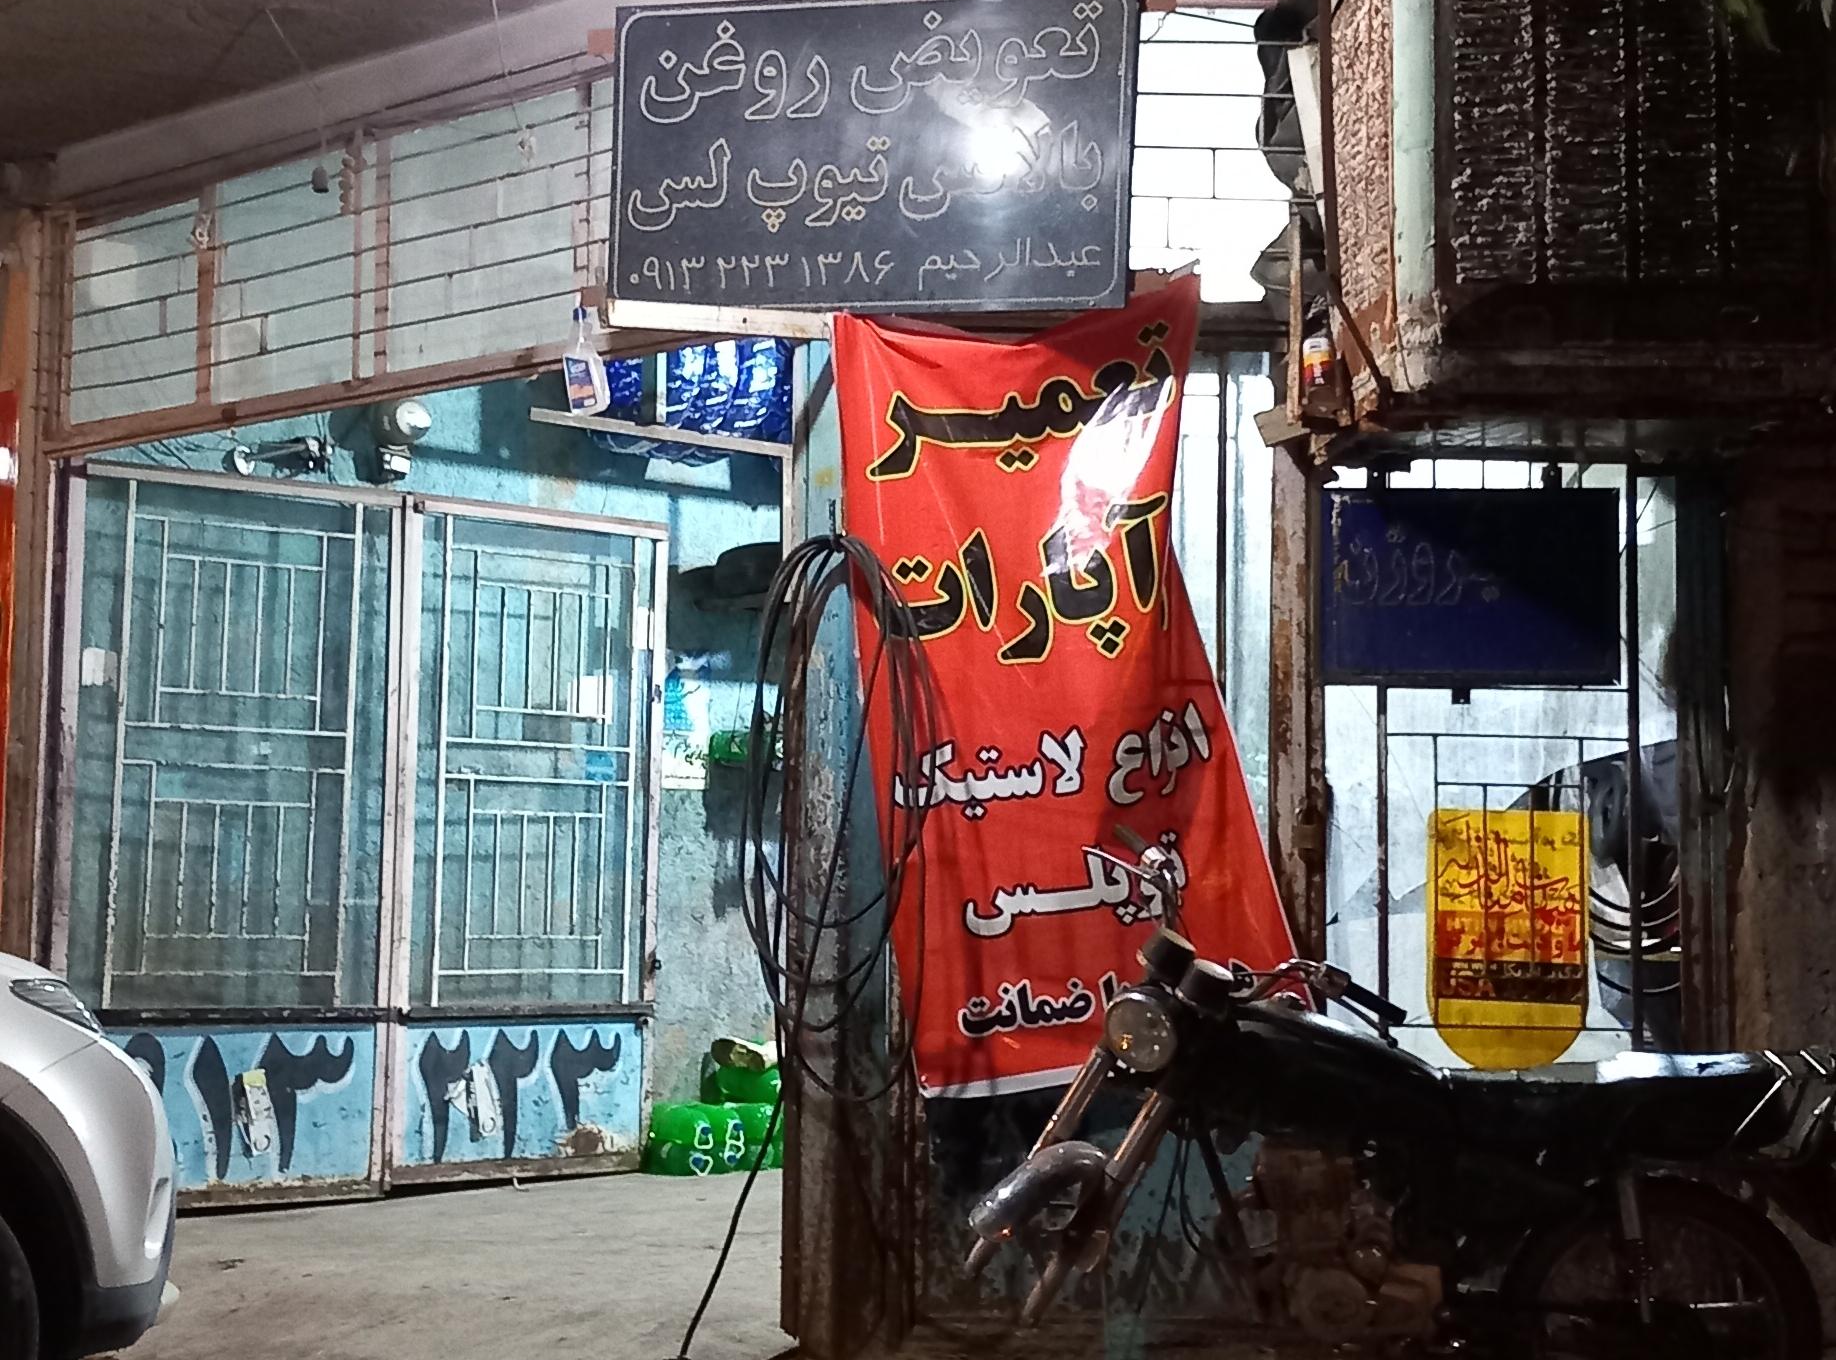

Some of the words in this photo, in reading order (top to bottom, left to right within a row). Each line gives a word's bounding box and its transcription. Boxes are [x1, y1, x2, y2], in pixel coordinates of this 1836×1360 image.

[639, 20, 831, 124] روغن
[850, 0, 1104, 114] تعویض
[627, 137, 733, 232] لس
[746, 135, 891, 233] تیوپ
[898, 119, 1104, 221] بالاس
[716, 252, 790, 290] ۲۲۳
[918, 237, 1102, 291] عبدالرحیم
[866, 321, 1177, 481] تعمیر
[877, 491, 1169, 663] آپارات
[893, 727, 1084, 817] لاستیک
[1107, 701, 1210, 805] انواع
[958, 978, 1095, 1038] ضمانت
[418, 1028, 621, 1165] ۲۲۳
